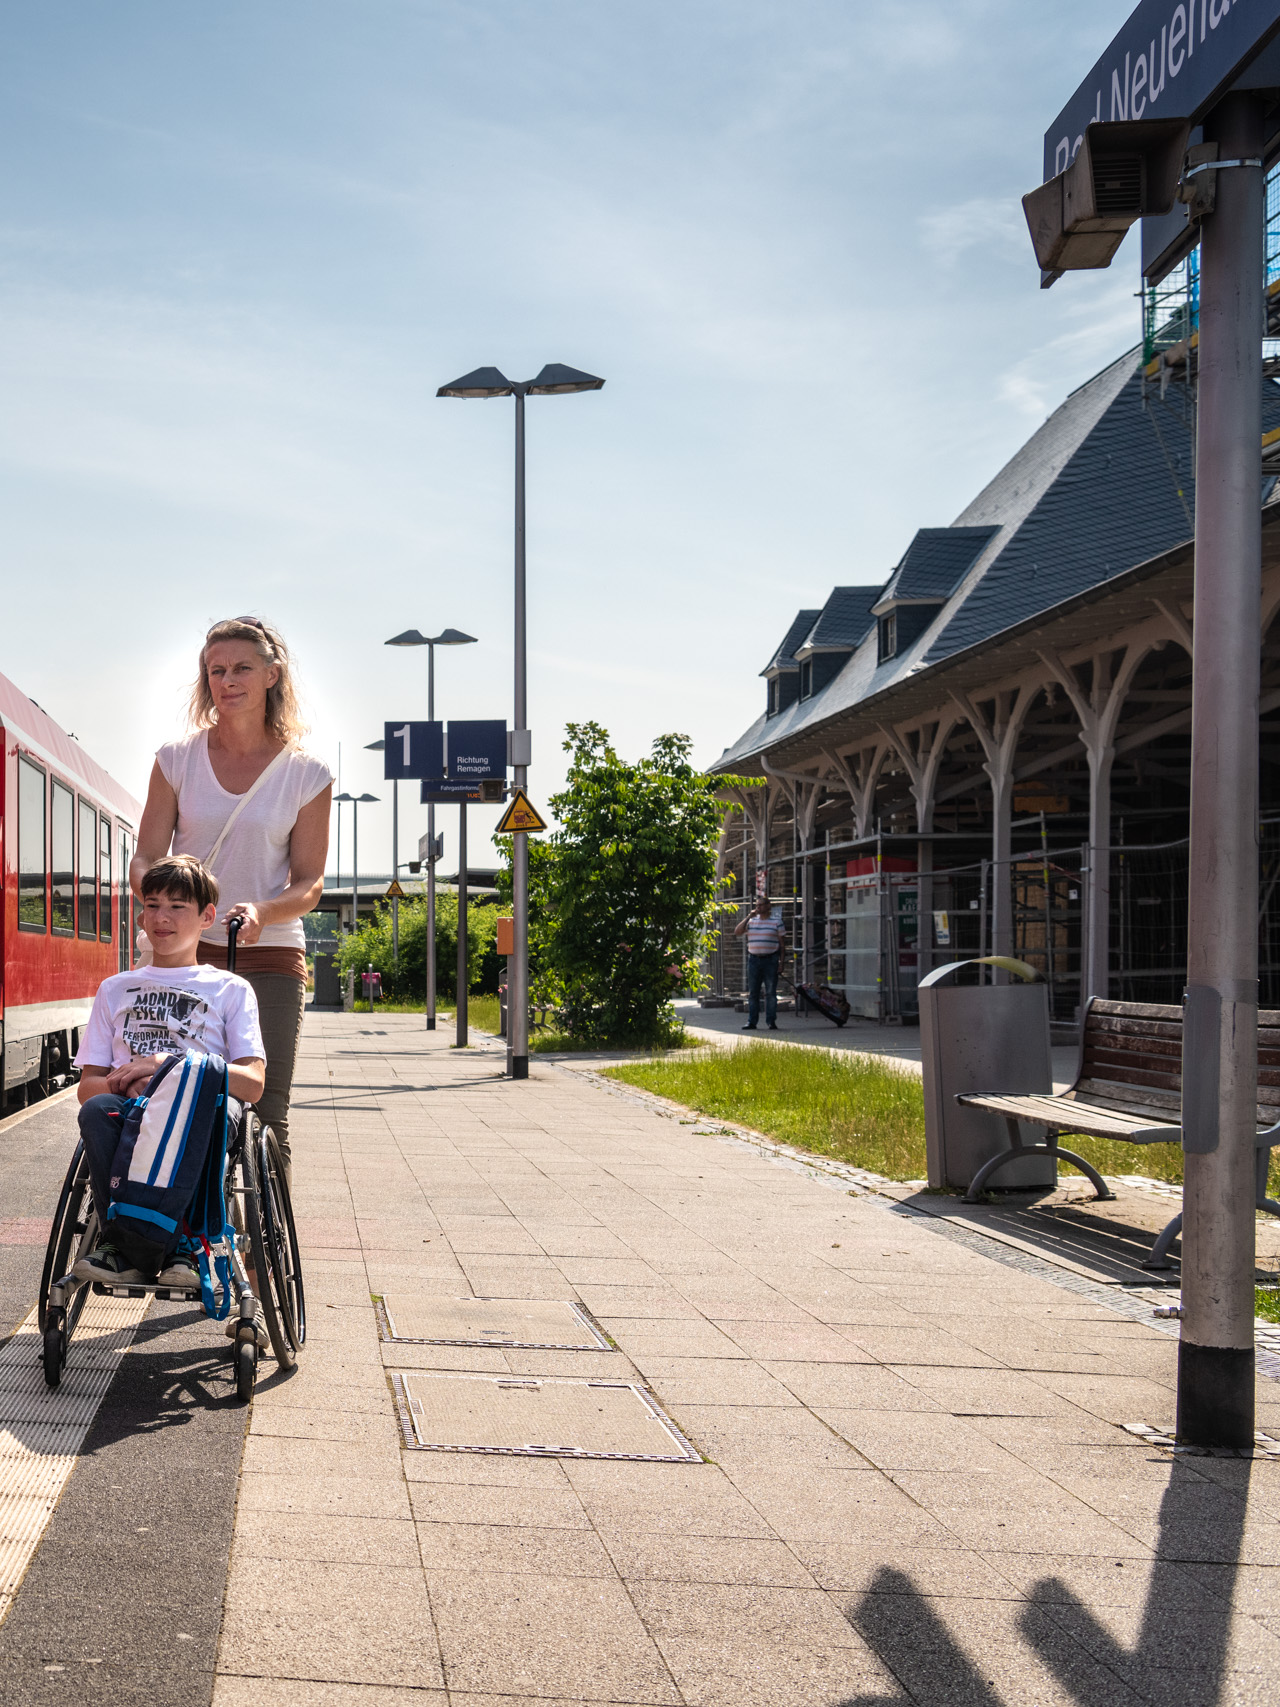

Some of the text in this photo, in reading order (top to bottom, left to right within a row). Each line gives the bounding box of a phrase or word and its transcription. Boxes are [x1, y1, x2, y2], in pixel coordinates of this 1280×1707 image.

[393, 724, 411, 766] 1
[456, 756, 489, 765] Richtung
[456, 765, 491, 773] Remagen
